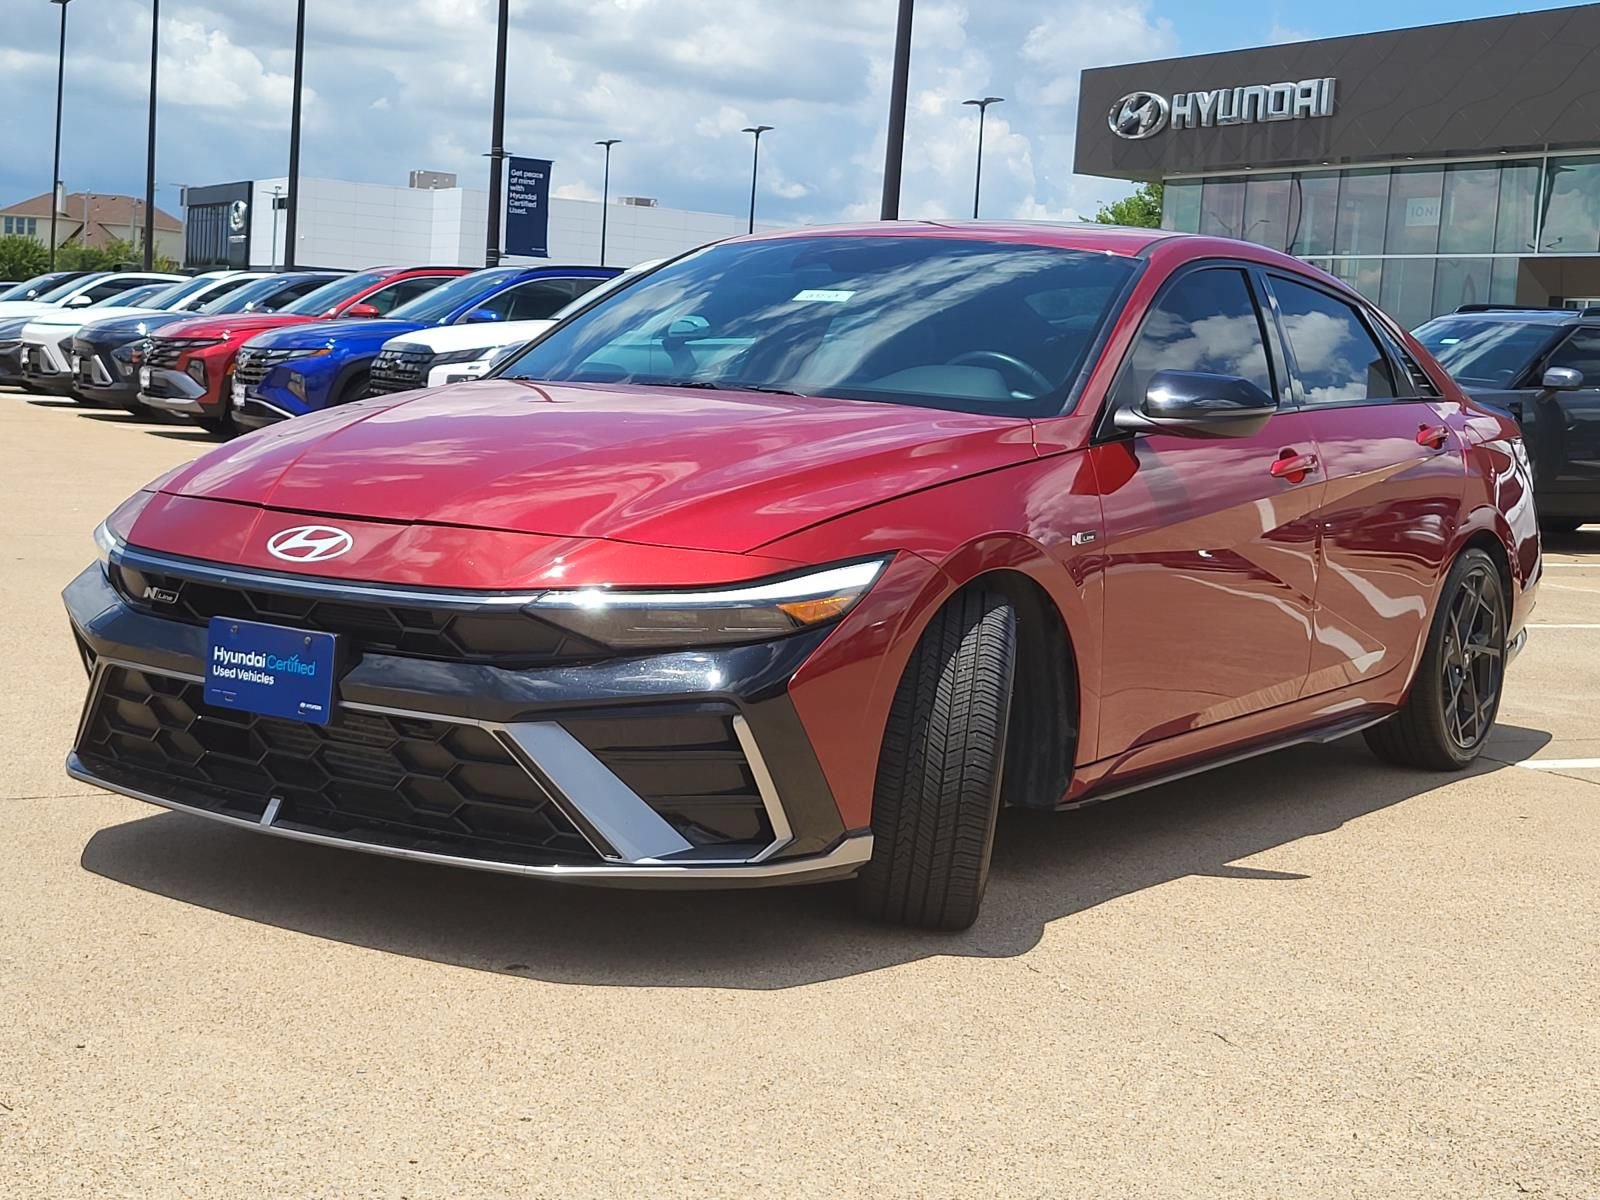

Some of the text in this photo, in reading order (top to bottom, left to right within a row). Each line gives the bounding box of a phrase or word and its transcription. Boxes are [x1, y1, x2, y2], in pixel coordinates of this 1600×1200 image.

[1171, 77, 1336, 130] HYUNDAI
[511, 169, 523, 177] Get
[518, 178, 535, 186] mind
[510, 192, 537, 201] Hyundai
[509, 200, 537, 208] Certified
[509, 207, 528, 215] Used.
[1072, 532, 1082, 546] N
[143, 586, 174, 601] N Line
[213, 646, 316, 676] Hyundai Certified
[213, 665, 275, 685] Used Vehicles
